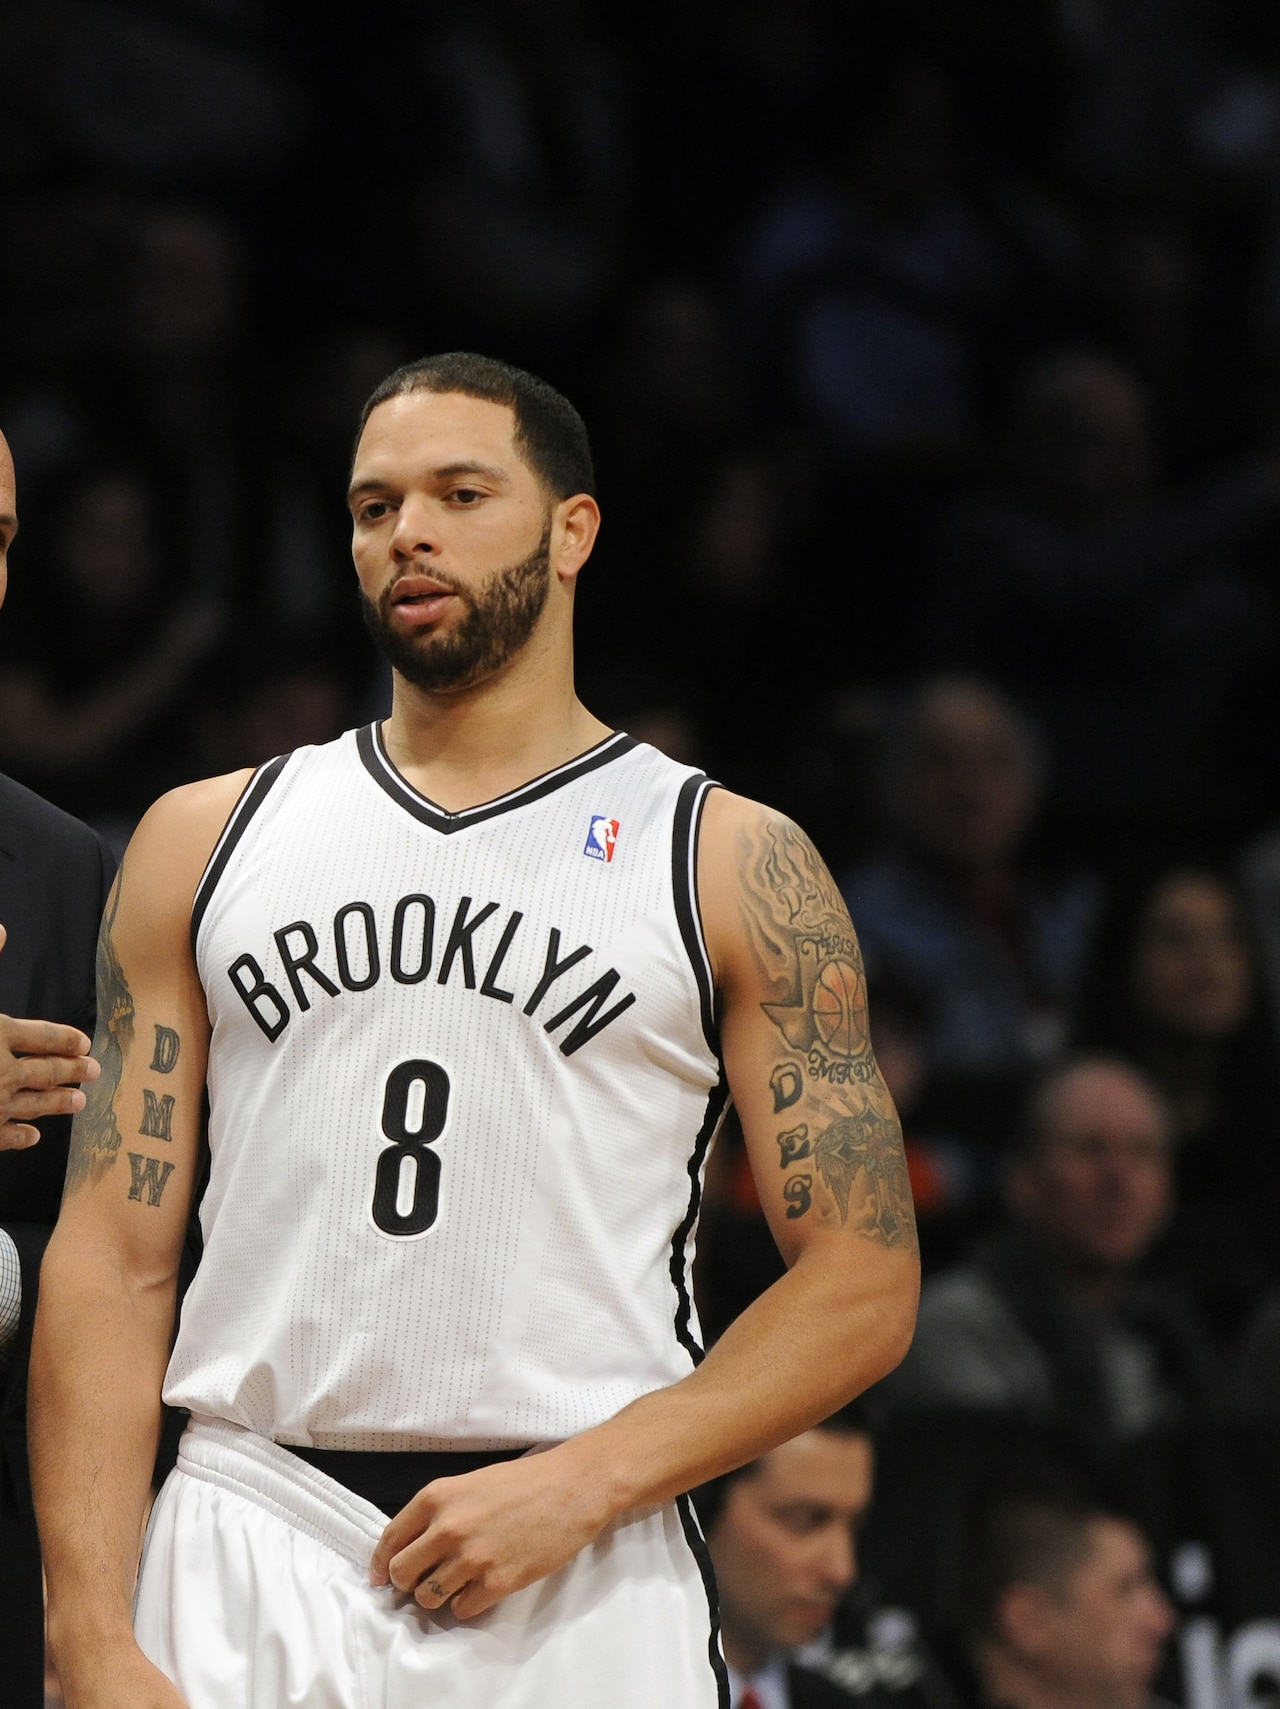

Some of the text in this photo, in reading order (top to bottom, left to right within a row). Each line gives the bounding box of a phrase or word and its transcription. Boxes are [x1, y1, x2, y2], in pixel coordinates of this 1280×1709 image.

[585, 845, 606, 860] NBA
[227, 893, 637, 1057] BROOKLYN
[370, 1058, 451, 1237] 8
